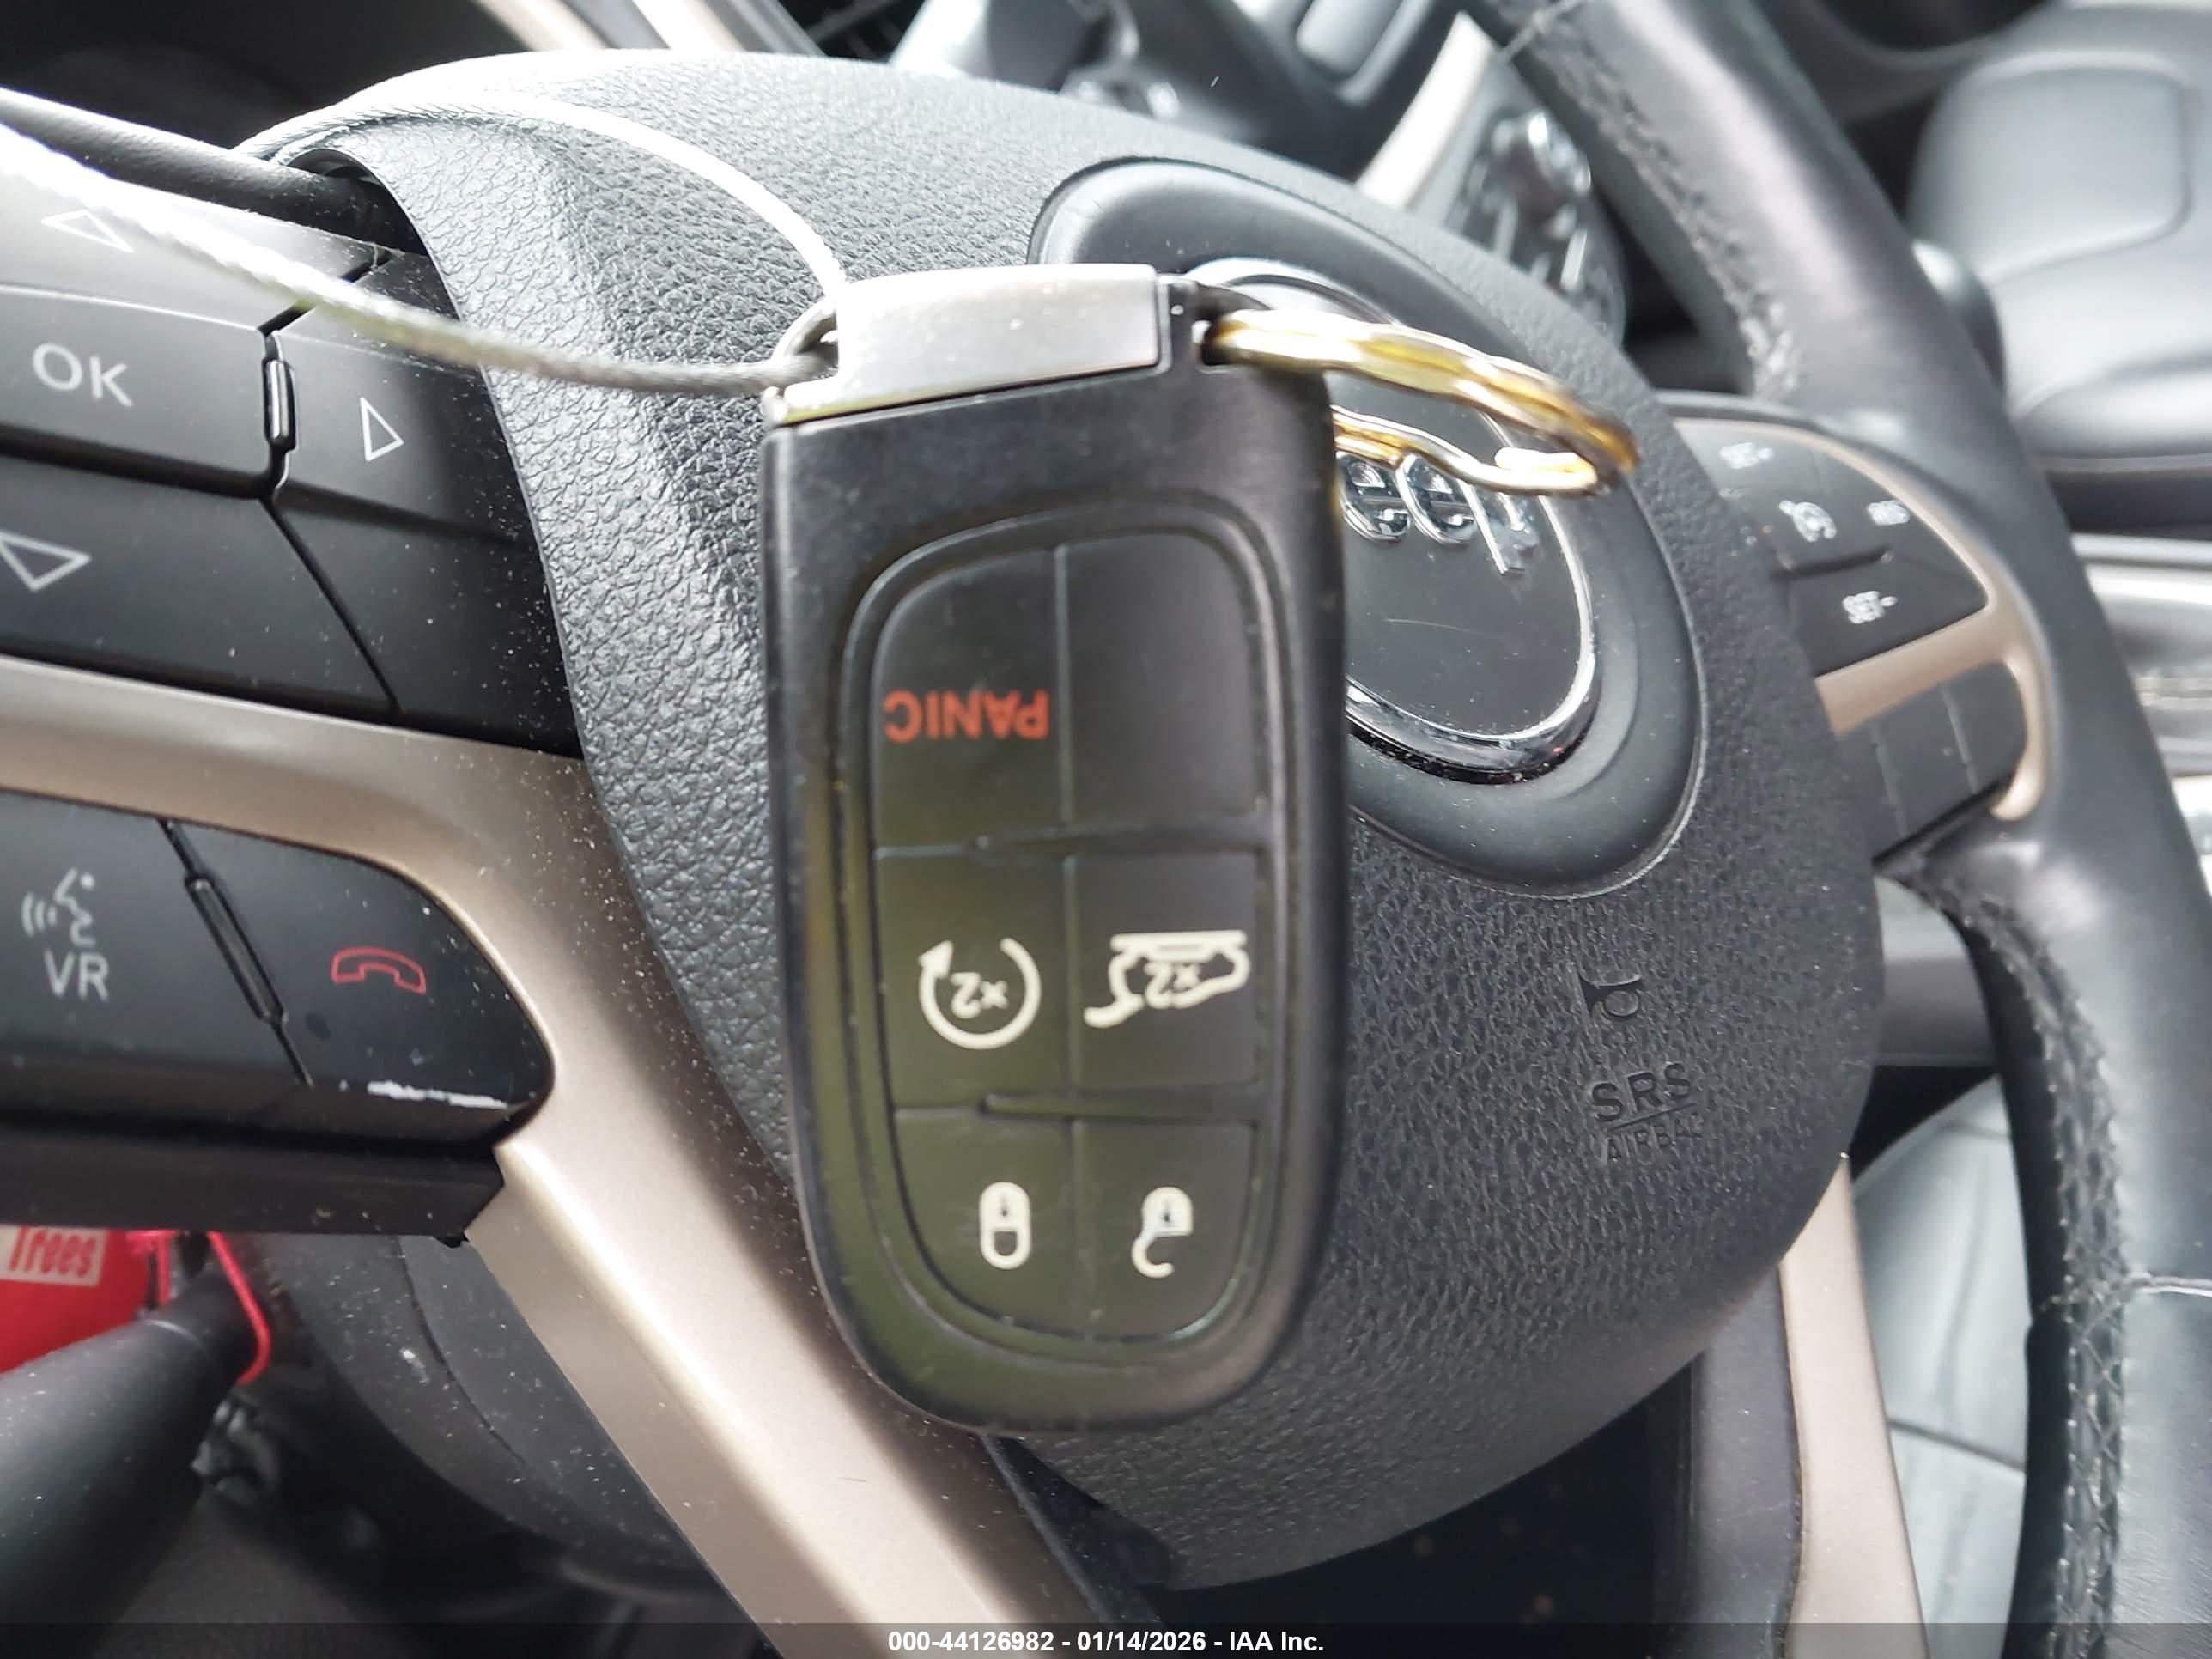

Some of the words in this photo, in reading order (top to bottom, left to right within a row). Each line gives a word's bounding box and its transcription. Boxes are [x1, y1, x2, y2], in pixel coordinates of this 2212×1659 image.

[33, 343, 133, 406] OK
[883, 689, 1049, 743] PANIC
[43, 948, 110, 1003] VR
[1591, 1063, 1691, 1122] SRS
